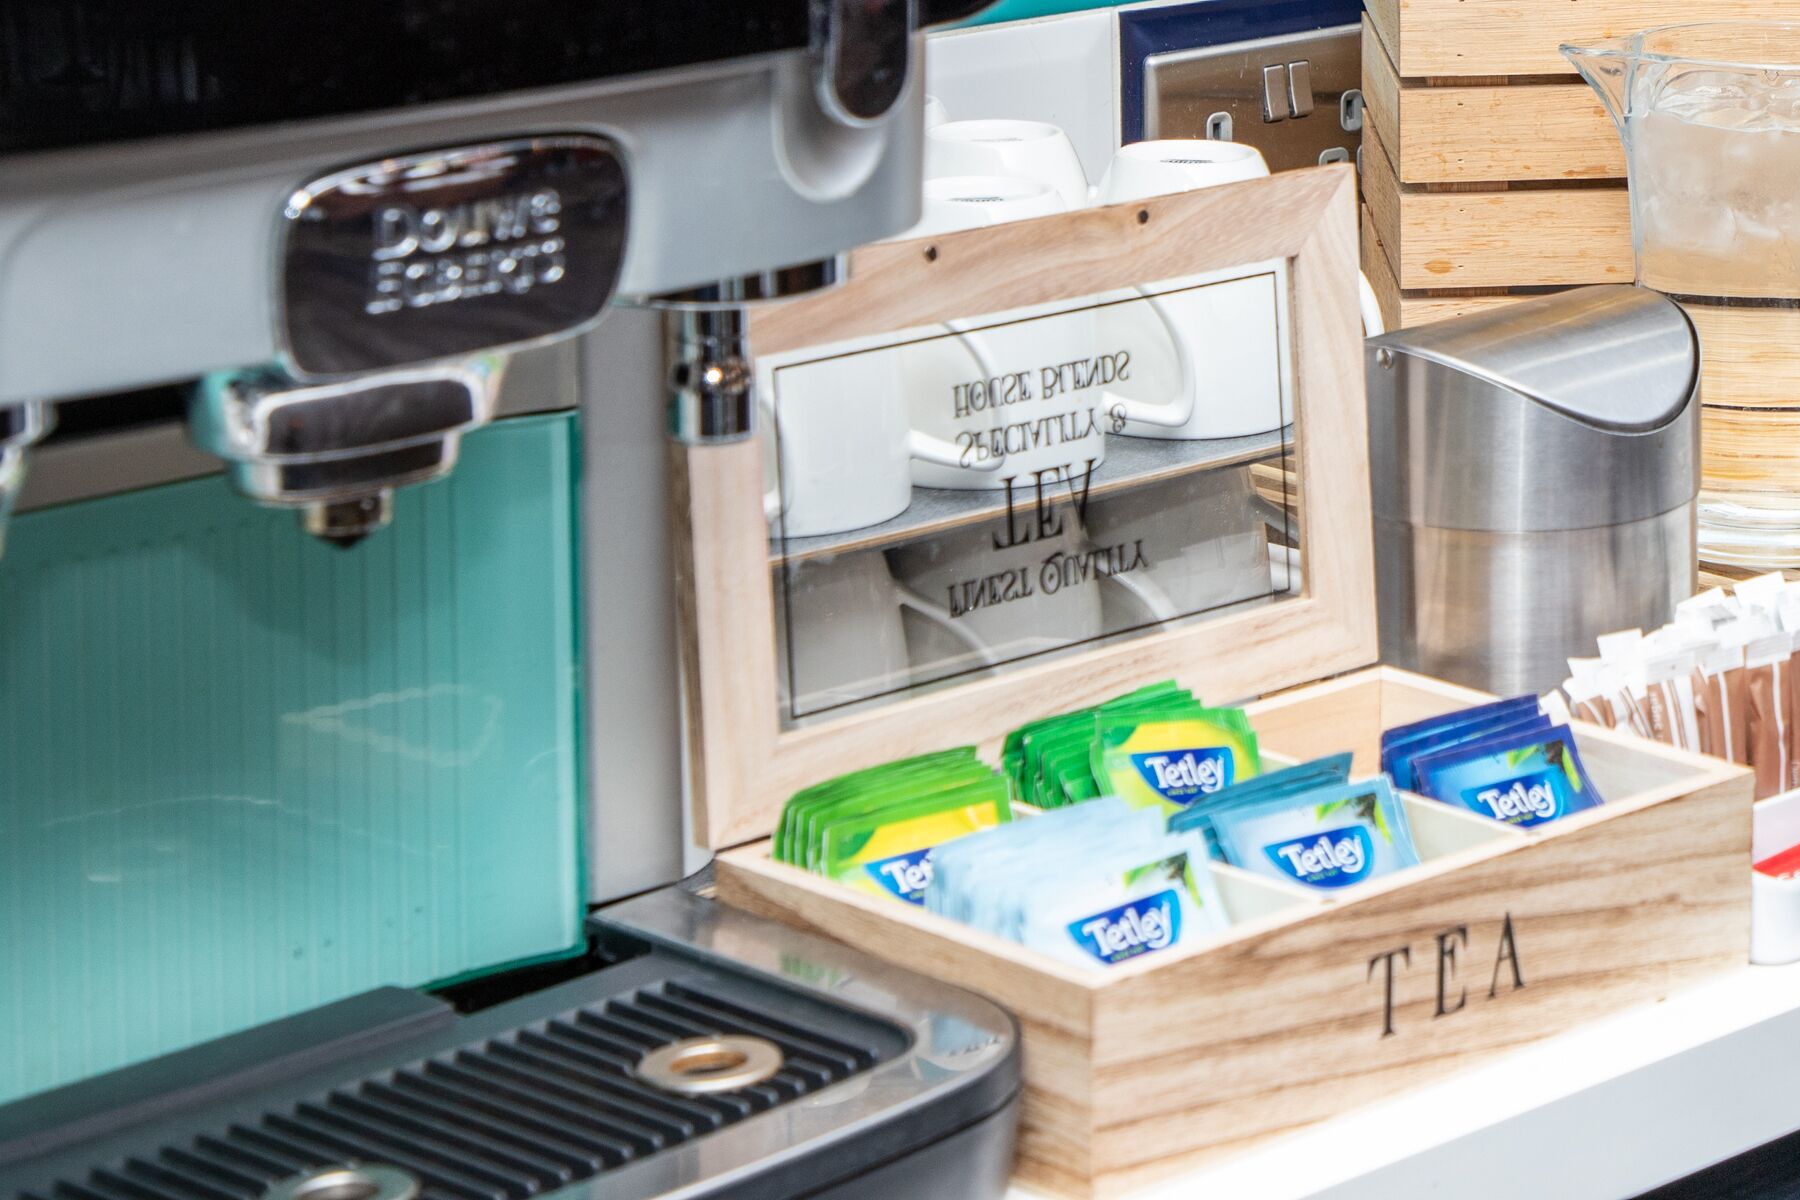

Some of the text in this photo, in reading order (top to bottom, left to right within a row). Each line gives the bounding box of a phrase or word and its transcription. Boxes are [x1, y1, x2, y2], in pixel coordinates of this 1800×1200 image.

[1144, 752, 1224, 793] Tetley
[1476, 779, 1556, 820] Tetley
[1277, 834, 1365, 877] Tetley
[1081, 899, 1173, 957] Tetley
[1366, 911, 1526, 1039] TEA
